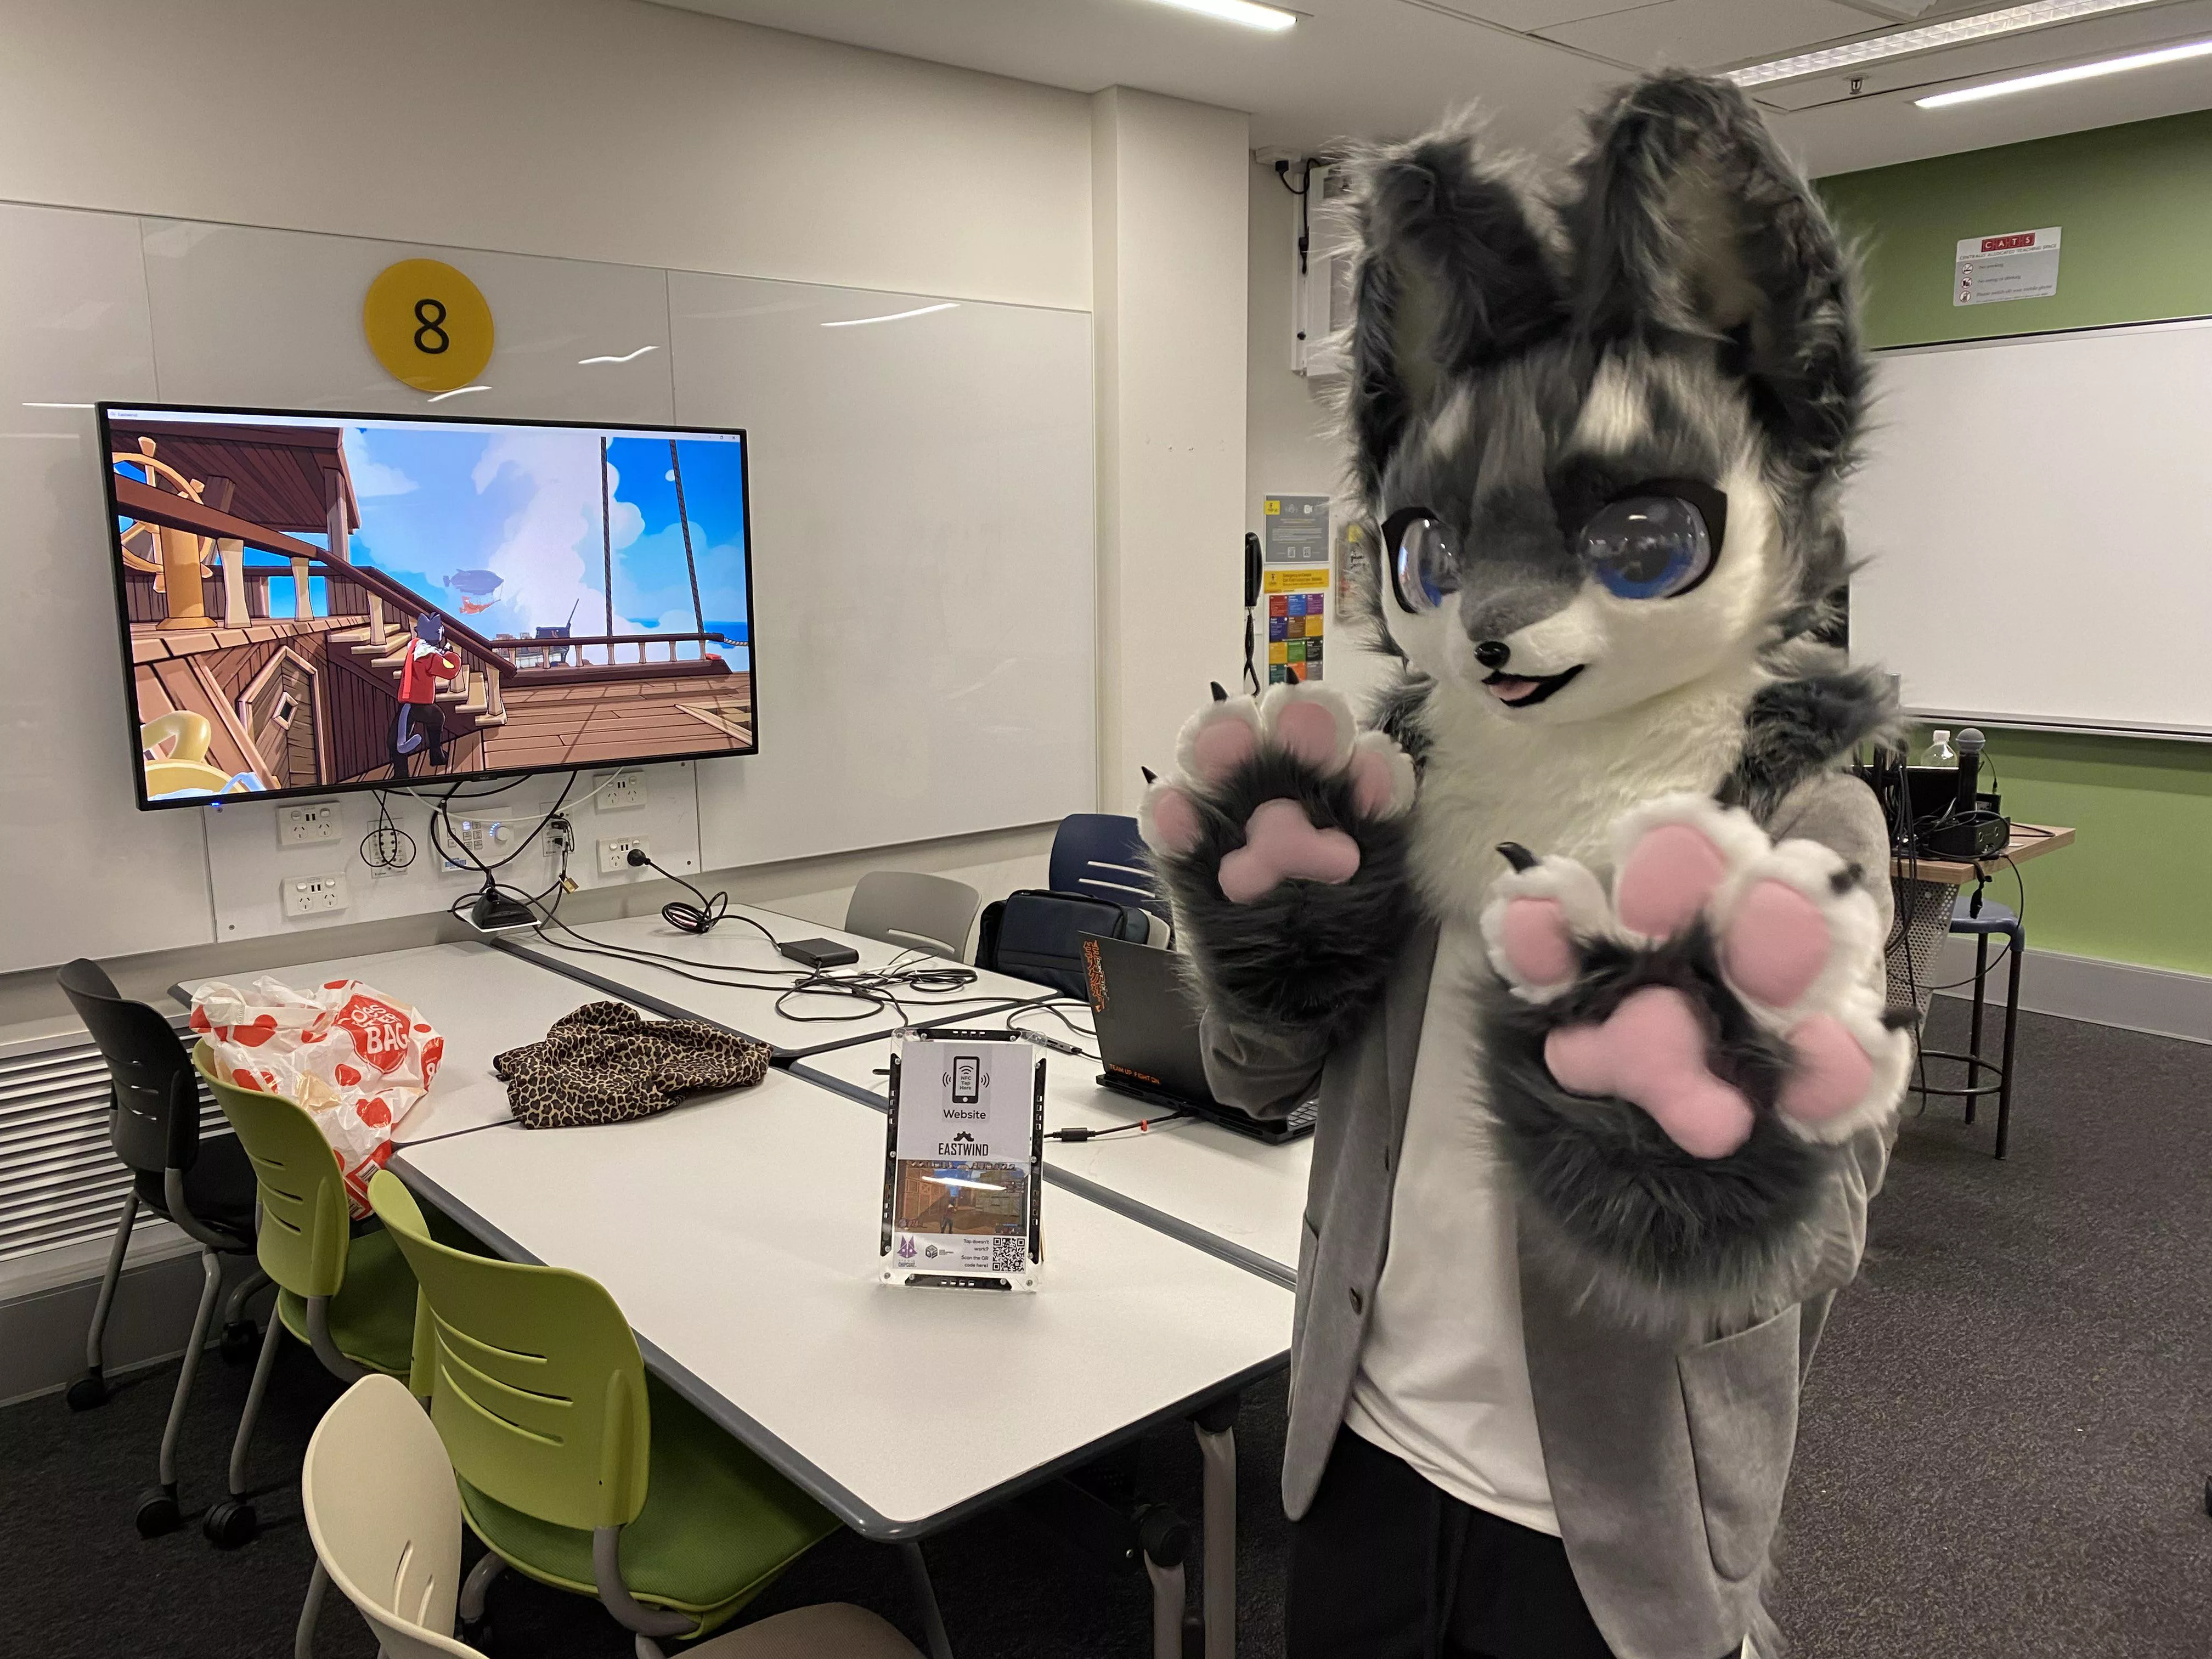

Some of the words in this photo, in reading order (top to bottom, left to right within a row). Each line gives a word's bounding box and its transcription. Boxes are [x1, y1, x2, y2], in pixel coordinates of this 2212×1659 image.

[1985, 236, 2031, 249] CATS
[414, 298, 449, 354] 8
[365, 1022, 410, 1054] BAG
[943, 1109, 986, 1119] Website
[939, 1143, 989, 1156] EASTWIND
